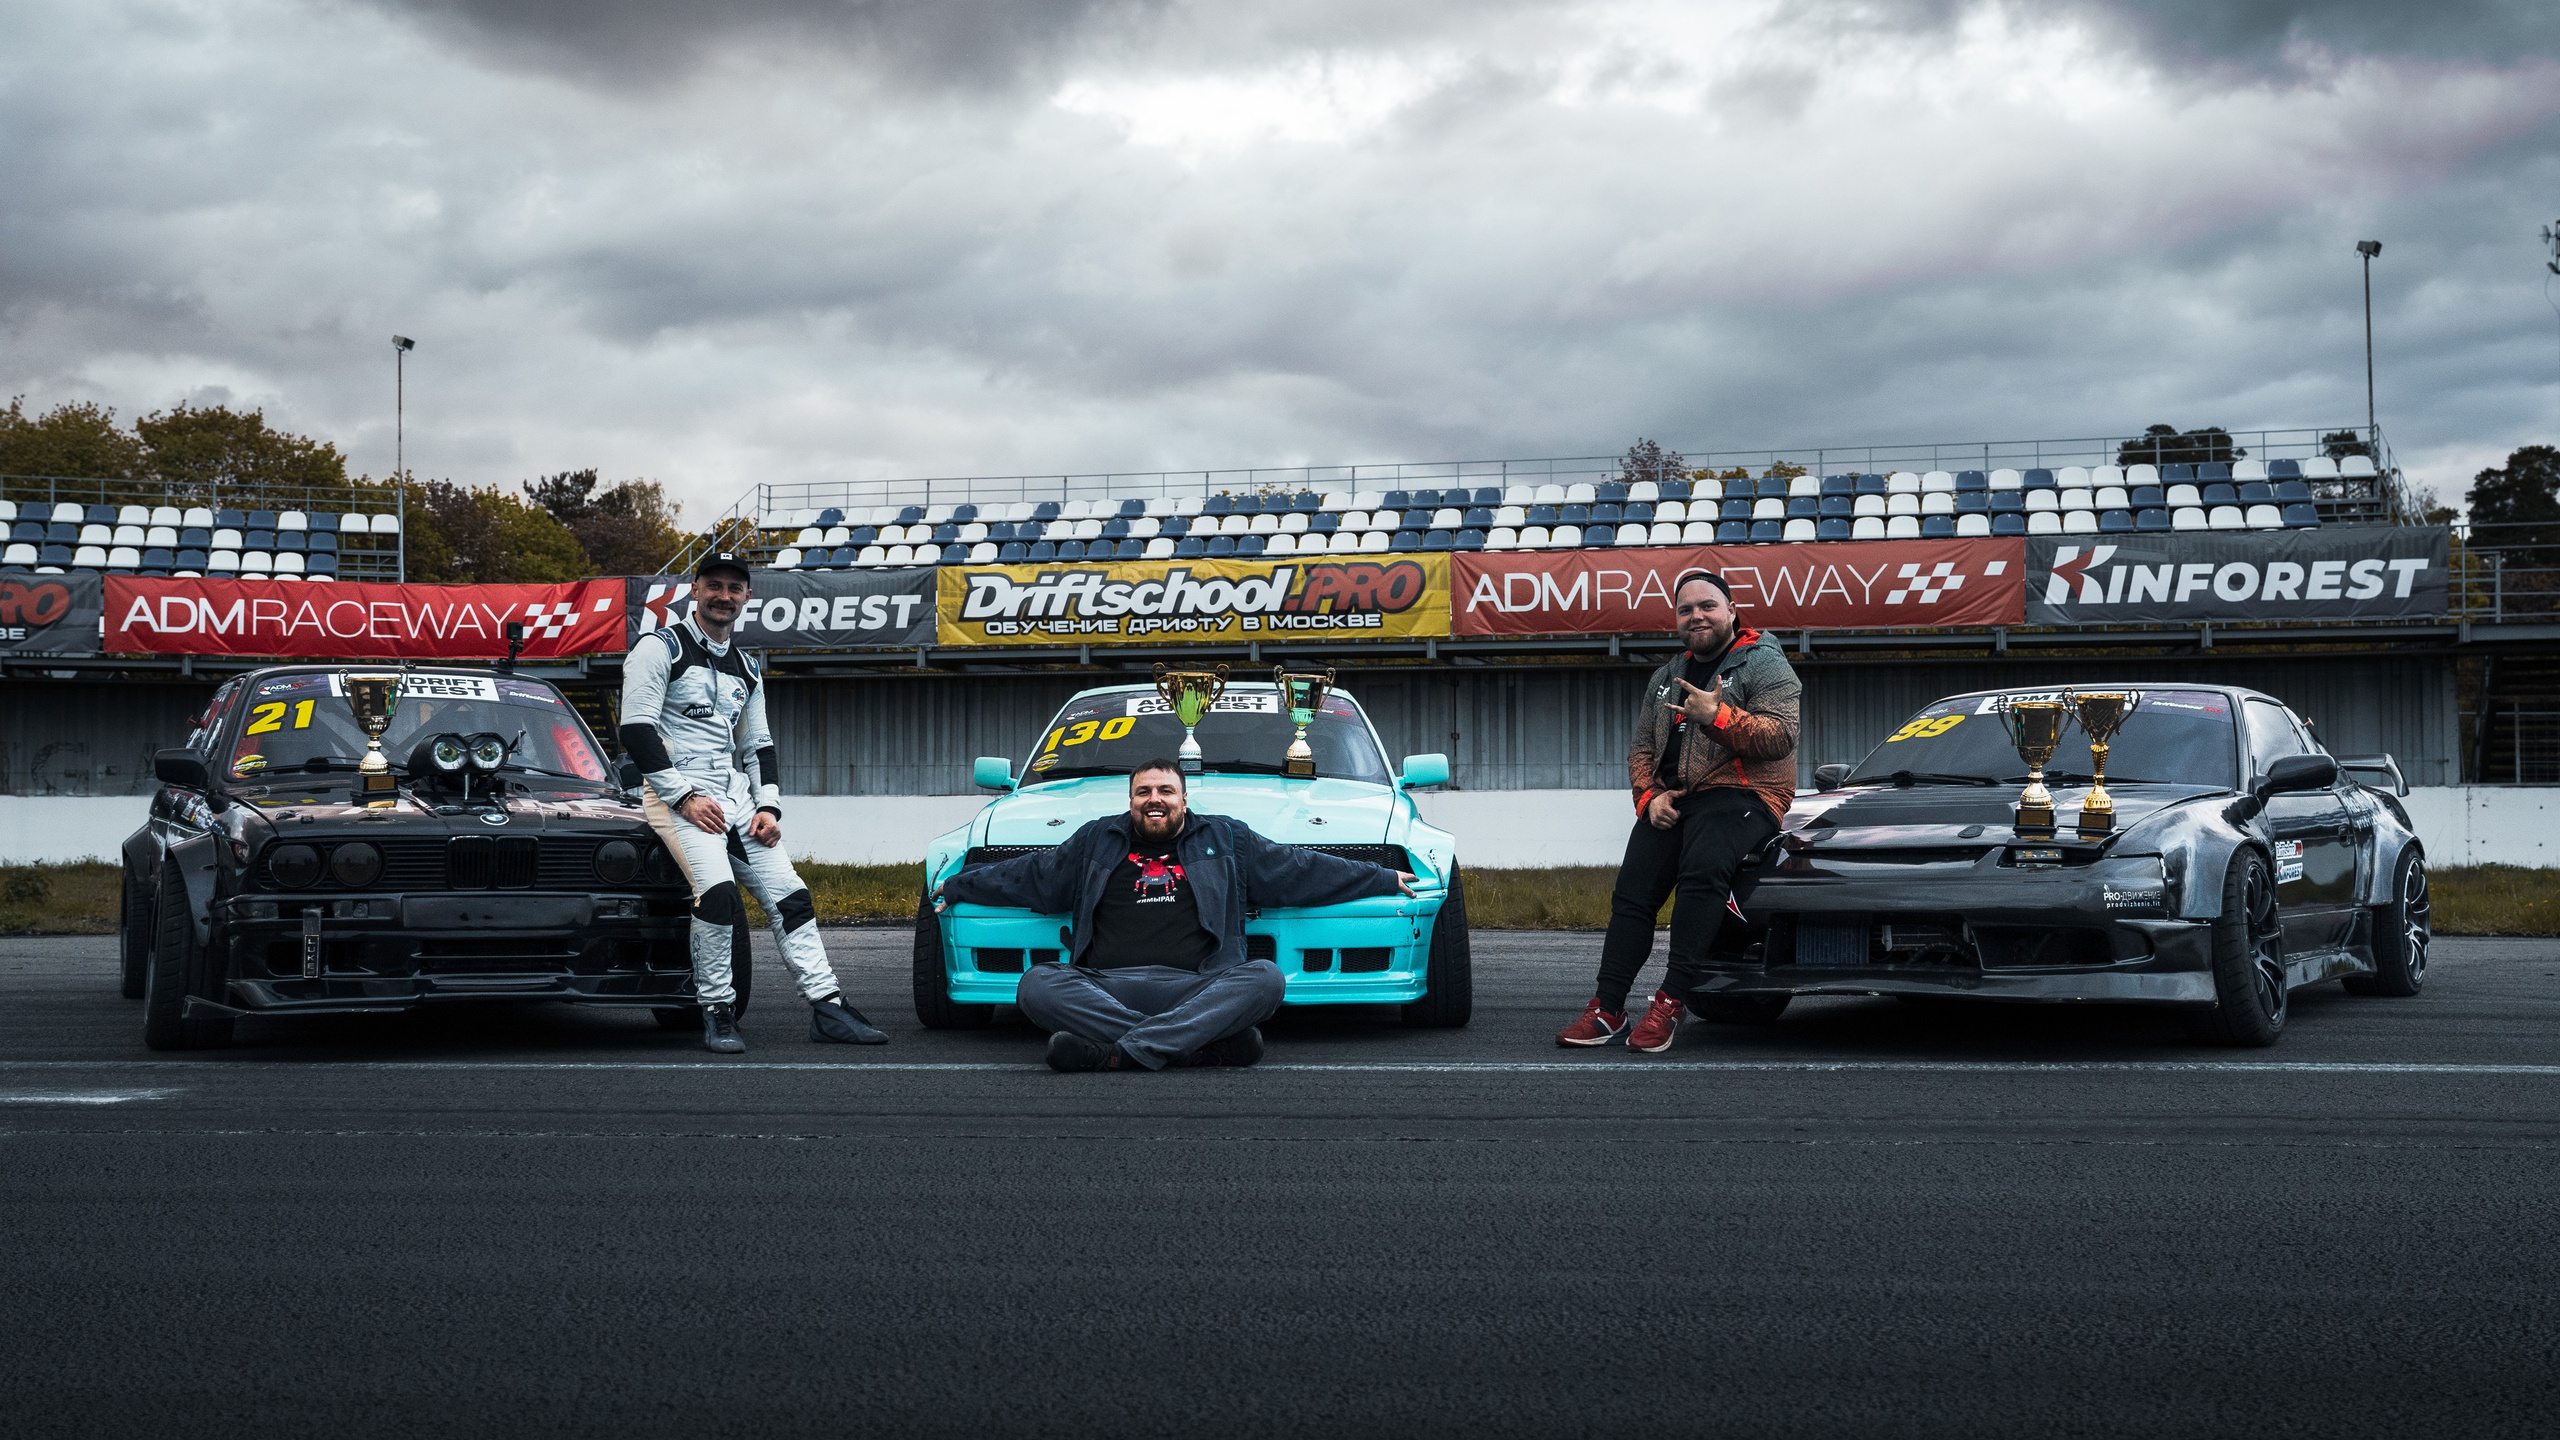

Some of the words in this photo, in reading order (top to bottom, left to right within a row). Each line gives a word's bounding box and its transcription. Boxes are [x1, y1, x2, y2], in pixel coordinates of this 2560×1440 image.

[2044, 545, 2429, 604] KINFOREST
[119, 595, 518, 640] ADMRACEWAY
[638, 583, 922, 635] KFOREST
[986, 619, 1119, 634] ОБУЧЕНИЕ
[1128, 617, 1231, 634] ДРИФТУ
[1243, 615, 1260, 630] В
[1263, 613, 1381, 629] МОСКВЕ
[409, 677, 482, 687] DRIFT
[246, 699, 315, 736] 21
[1043, 716, 1137, 754] 130
[1886, 714, 1966, 743] 99
